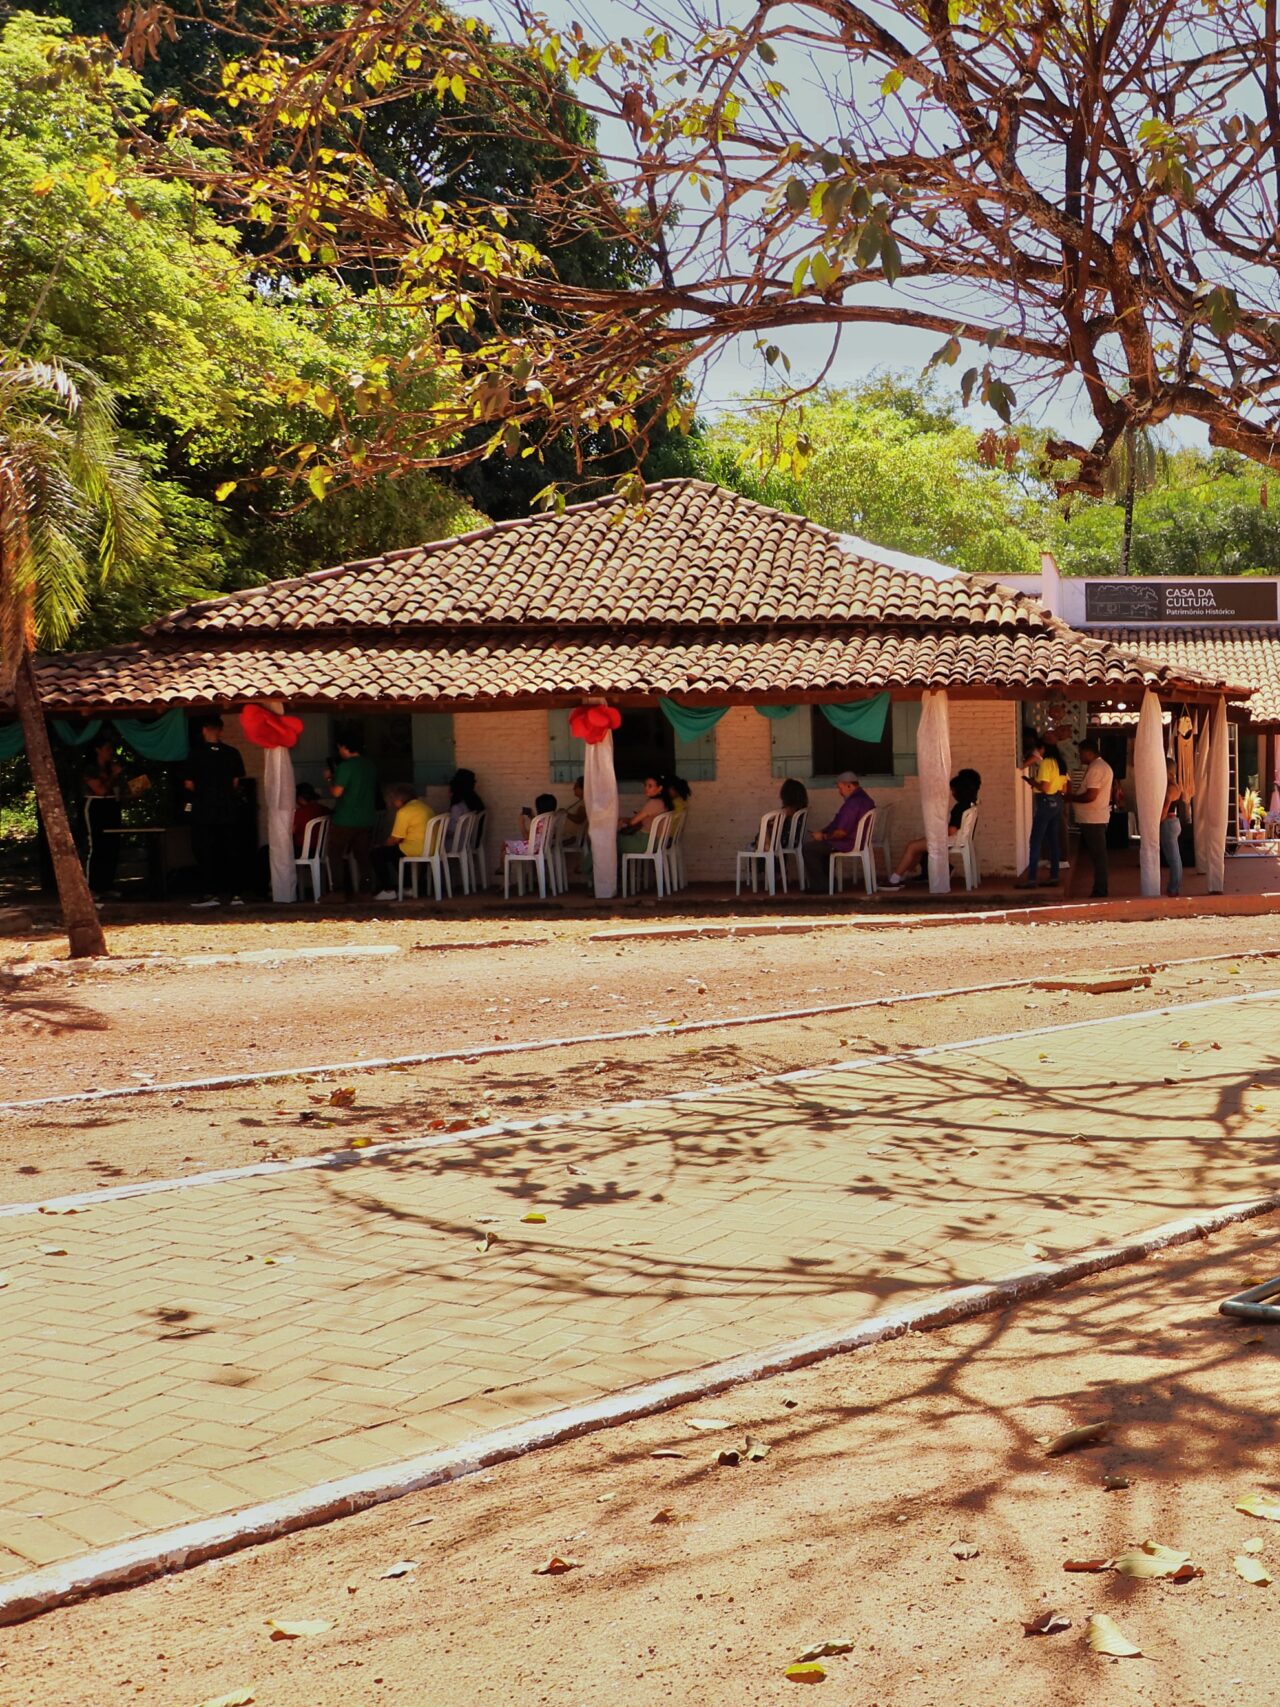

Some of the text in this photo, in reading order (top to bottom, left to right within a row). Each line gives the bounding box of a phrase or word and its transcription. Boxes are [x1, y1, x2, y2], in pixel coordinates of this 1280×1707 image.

[1166, 588, 1214, 597] CASA DA
[1166, 598, 1217, 607] CULTURA
